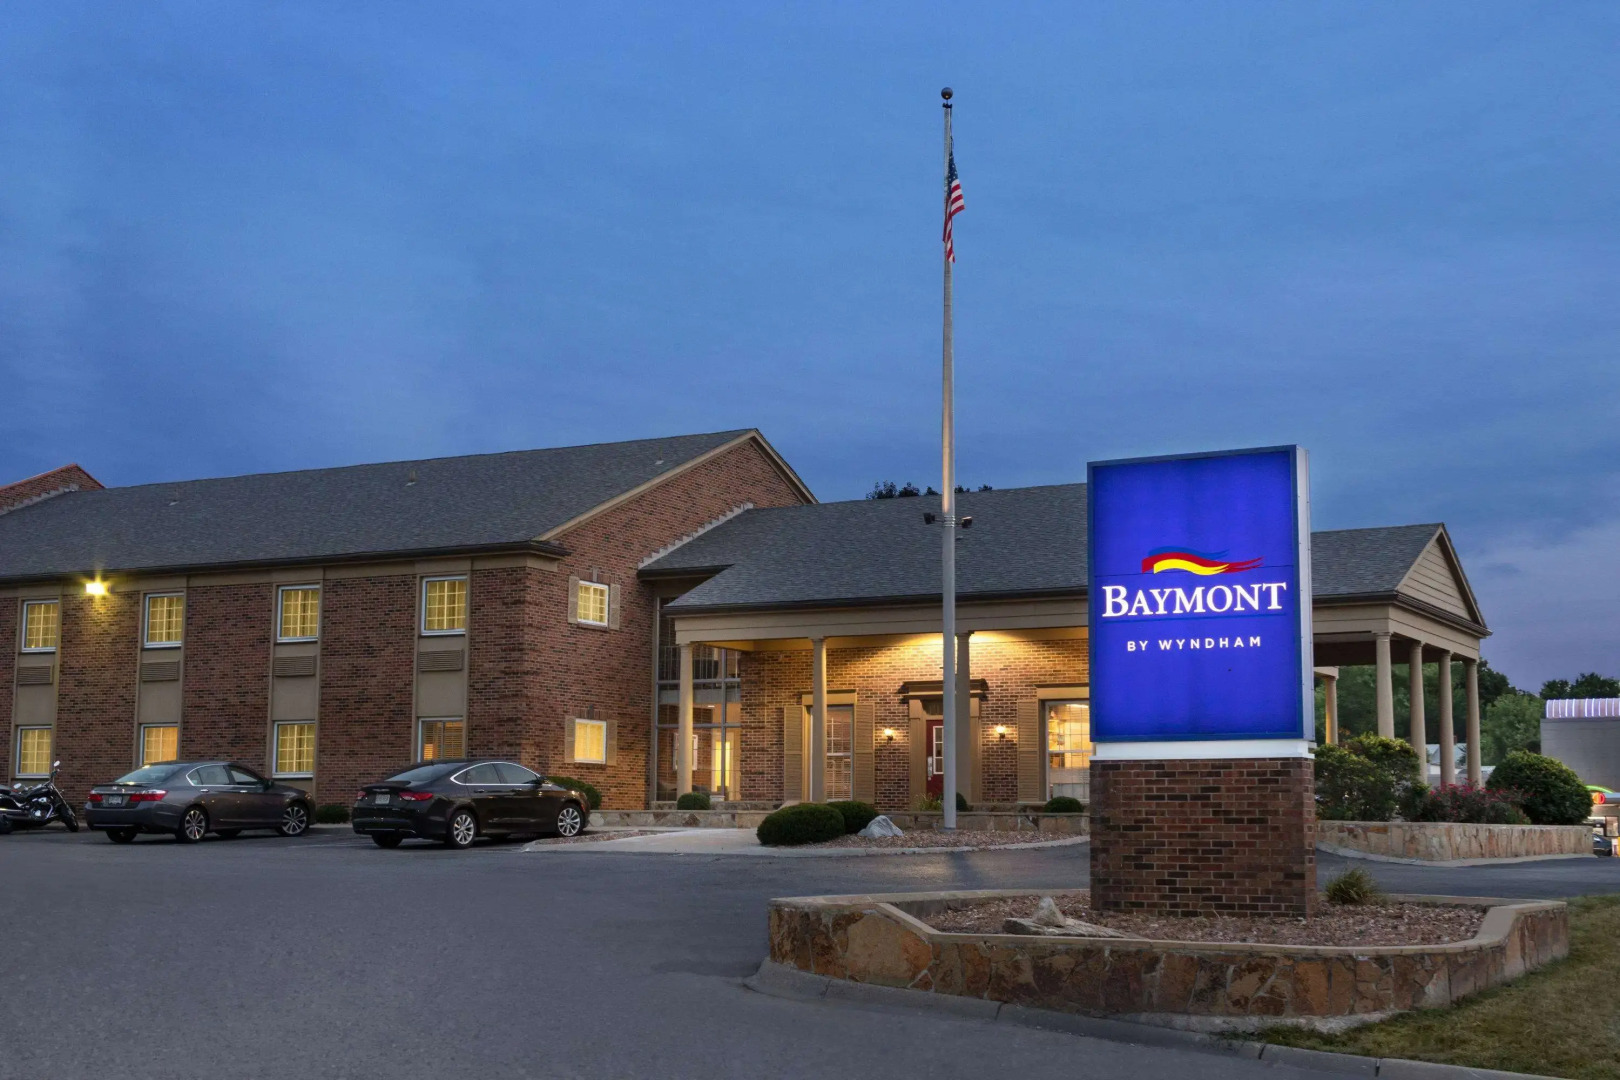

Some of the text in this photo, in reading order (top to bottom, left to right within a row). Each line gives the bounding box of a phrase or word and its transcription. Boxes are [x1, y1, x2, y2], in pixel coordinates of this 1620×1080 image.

[1101, 582, 1287, 618] BAYMONT
[1126, 636, 1262, 652] BY WYNDHAM
